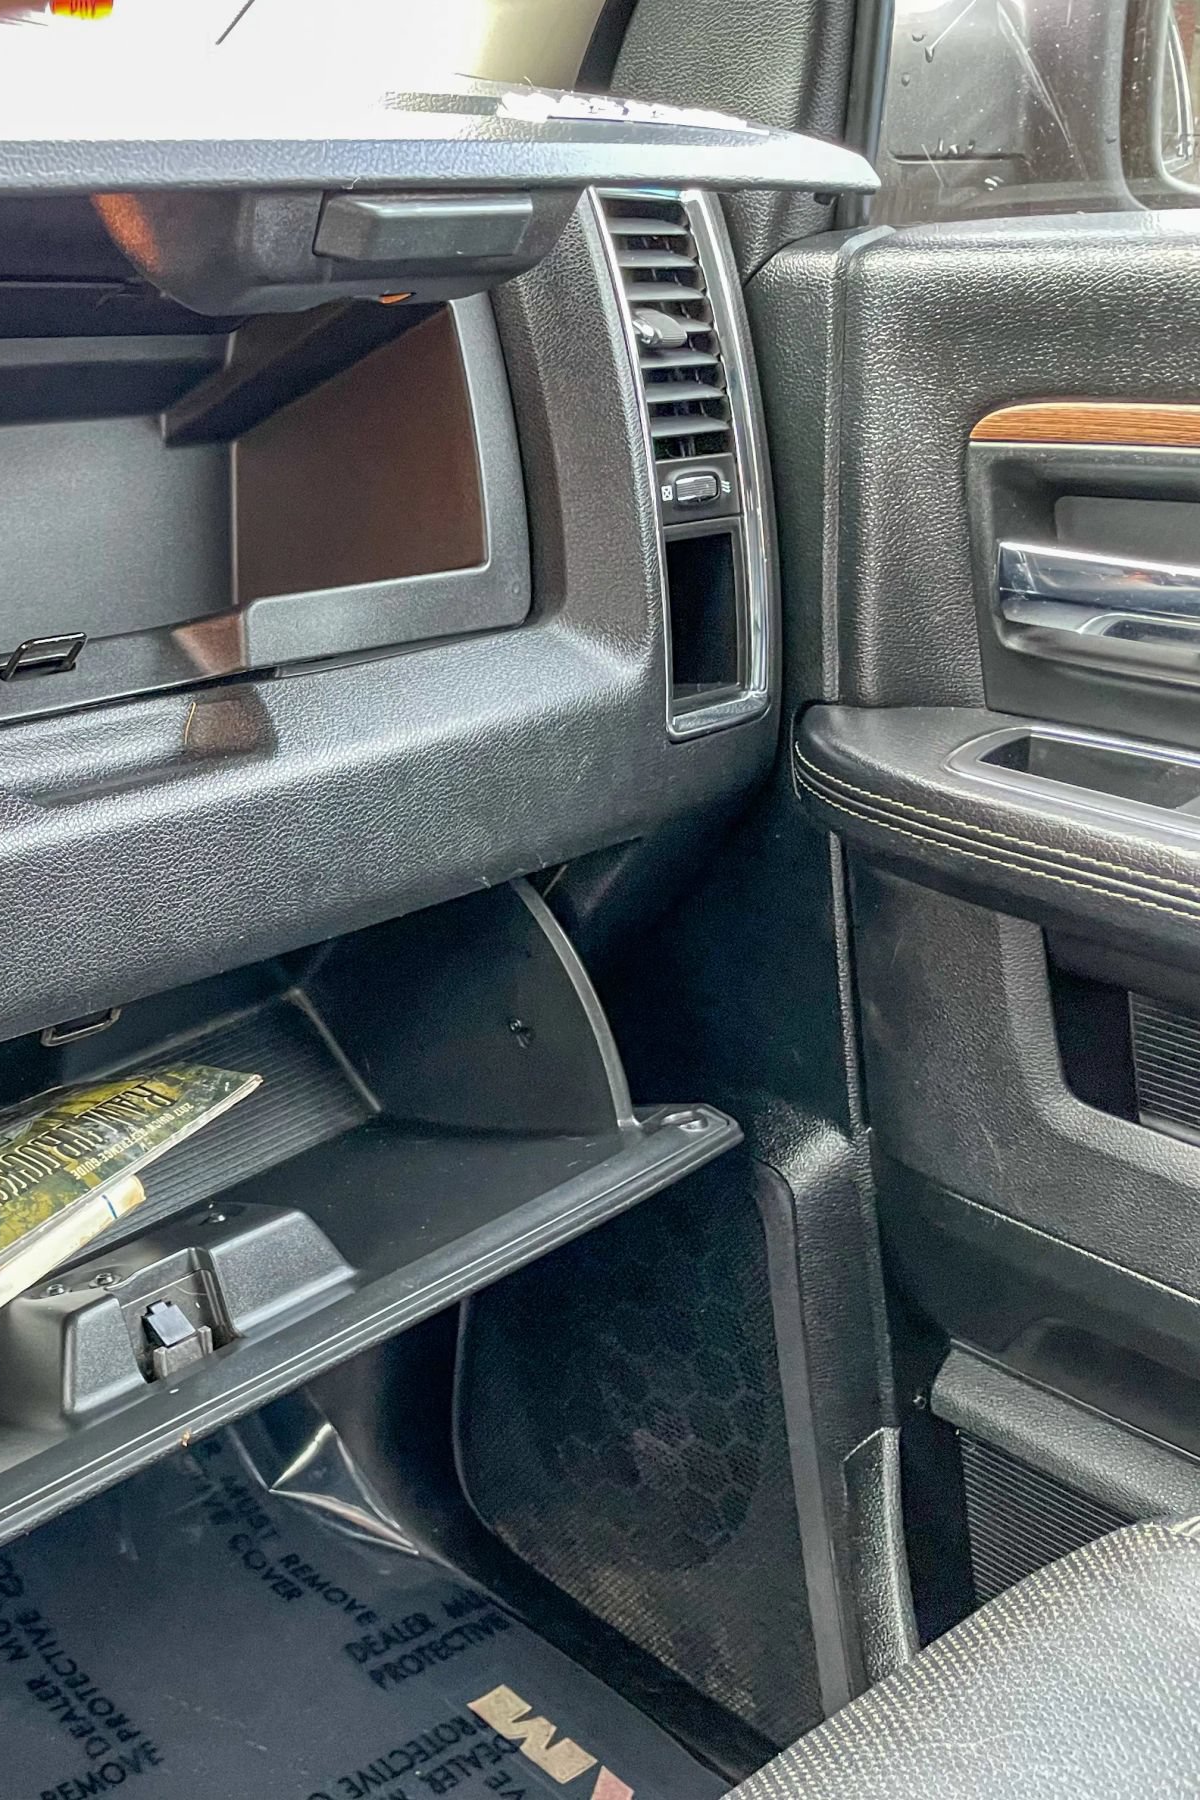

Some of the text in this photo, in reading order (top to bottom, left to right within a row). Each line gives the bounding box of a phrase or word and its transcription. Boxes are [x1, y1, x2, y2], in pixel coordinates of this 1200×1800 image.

[70, 1102, 195, 1180] 2017 QUICK REFERENCE GUIDE
[74, 1080, 177, 1135] RAM
[228, 1533, 304, 1601] COVER
[279, 1553, 378, 1627] REMOVE
[16, 1608, 142, 1743] PROTECTIVE
[26, 1674, 112, 1761] DEALER
[420, 1734, 519, 1795] DEALER
